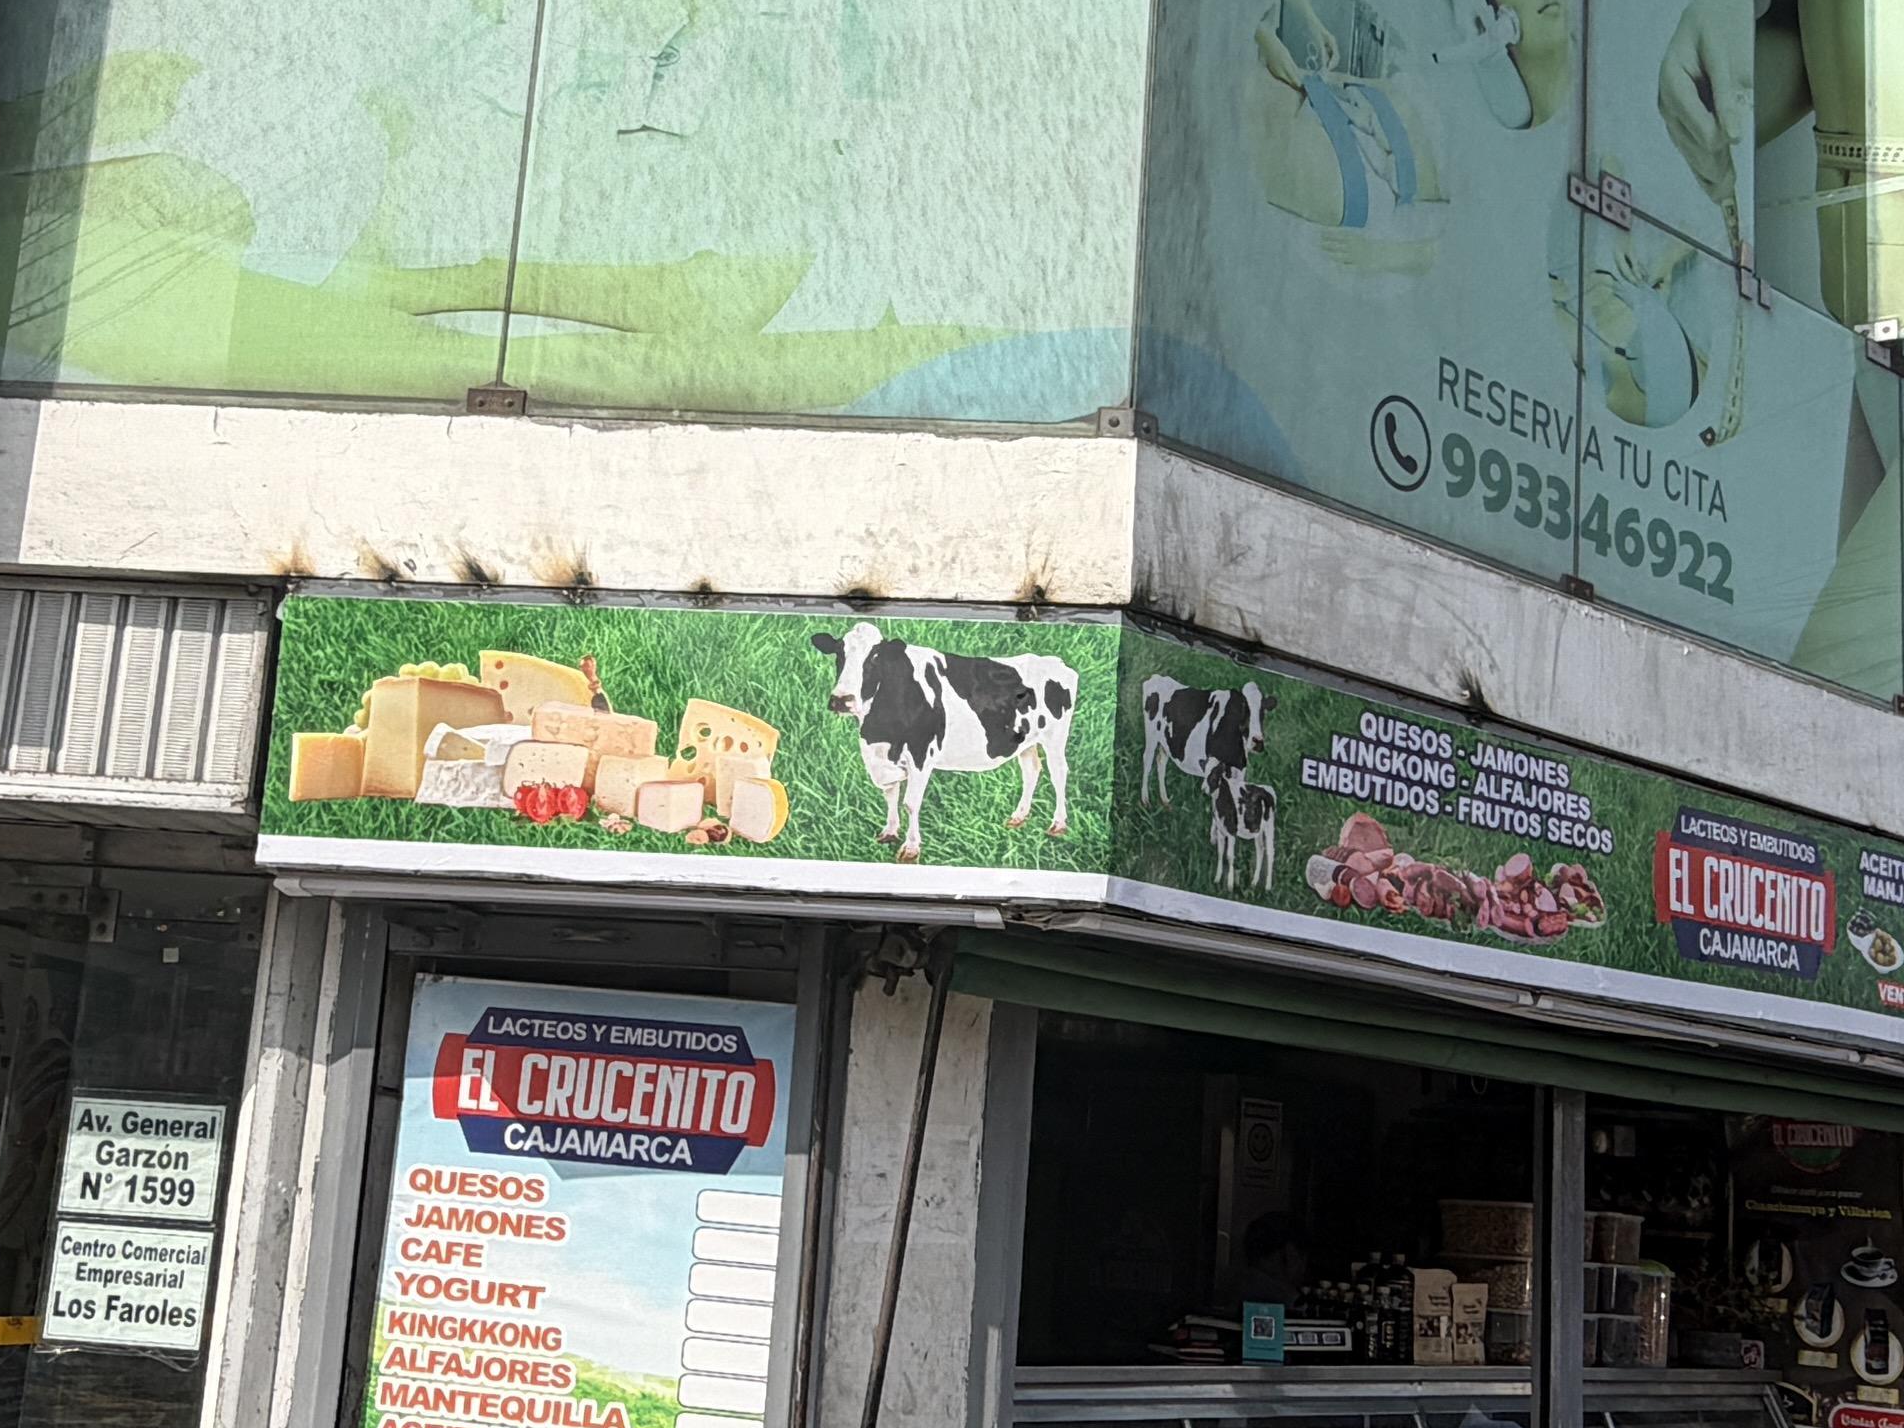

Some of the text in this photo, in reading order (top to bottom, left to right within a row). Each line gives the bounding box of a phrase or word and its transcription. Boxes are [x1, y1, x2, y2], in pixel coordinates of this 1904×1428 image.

[1436, 354, 1730, 525] RESERVA TU CITA
[1439, 430, 1737, 608] 993346922
[1360, 712, 1570, 789] QUESOS JAMONES
[1332, 735, 1592, 822] KINGKONG ALFAJORES
[1302, 758, 1614, 855] EMBUTIDOS FRUTOS SECOS
[1681, 815, 1816, 864] LACTEOS Y EMBUTIDOS
[1669, 848, 1694, 915] EL
[1699, 928, 1800, 971] CAJAMARCA
[487, 1017, 738, 1054] LACTEOS Y EMBUTIDOS
[458, 1047, 499, 1113] EL
[75, 1108, 217, 1140] Av. General
[505, 1123, 693, 1165] CAJAMARCA
[95, 1139, 189, 1172] Garzón
[125, 1177, 196, 1208] 1599
[408, 1168, 545, 1203] QUESOS
[404, 1205, 567, 1241] JAMONES
[60, 1234, 206, 1267] Centro Comercial
[401, 1238, 484, 1267] CAFE
[75, 1262, 185, 1291] Empresarial
[395, 1272, 545, 1310] YOGURT
[51, 1291, 197, 1330] Los Faroles
[387, 1310, 562, 1352] KINGKKONG
[385, 1346, 571, 1387] ALFAJORES
